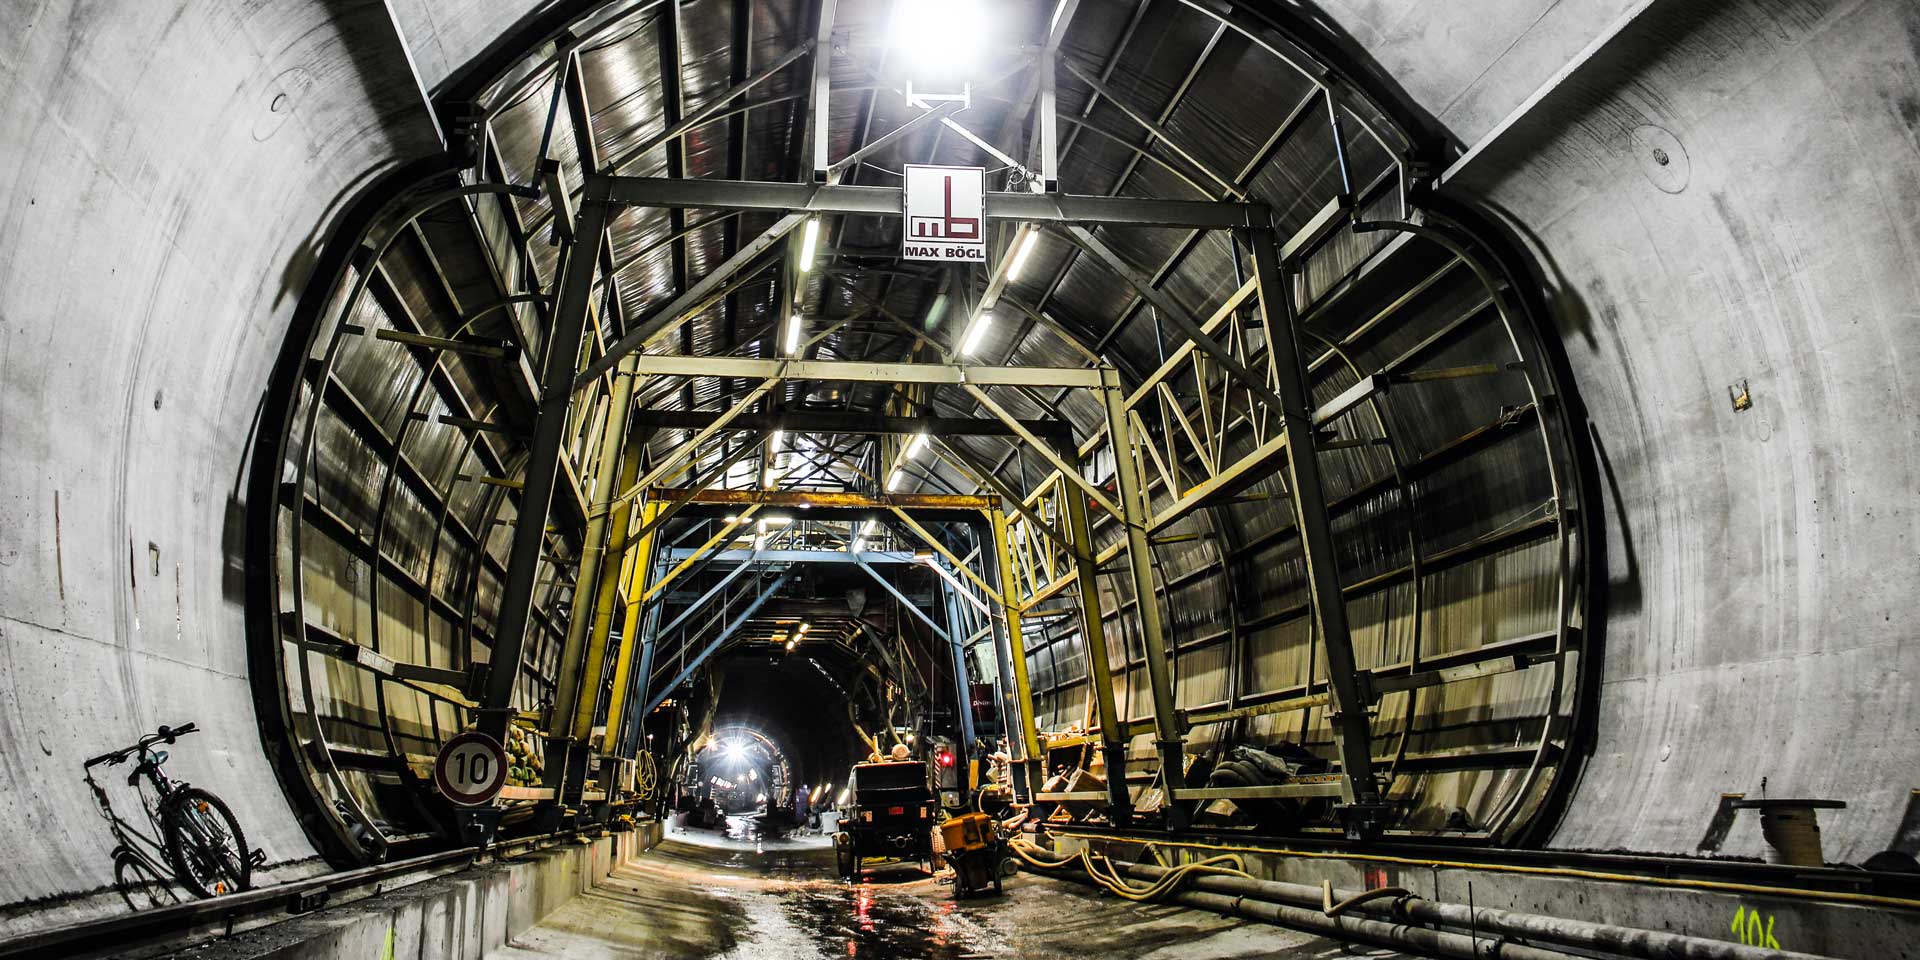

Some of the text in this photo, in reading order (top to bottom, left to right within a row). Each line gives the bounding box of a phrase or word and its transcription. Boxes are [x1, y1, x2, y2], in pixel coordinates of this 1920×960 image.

[905, 245, 985, 259] MAX BÖGL
[455, 752, 489, 784] 10
